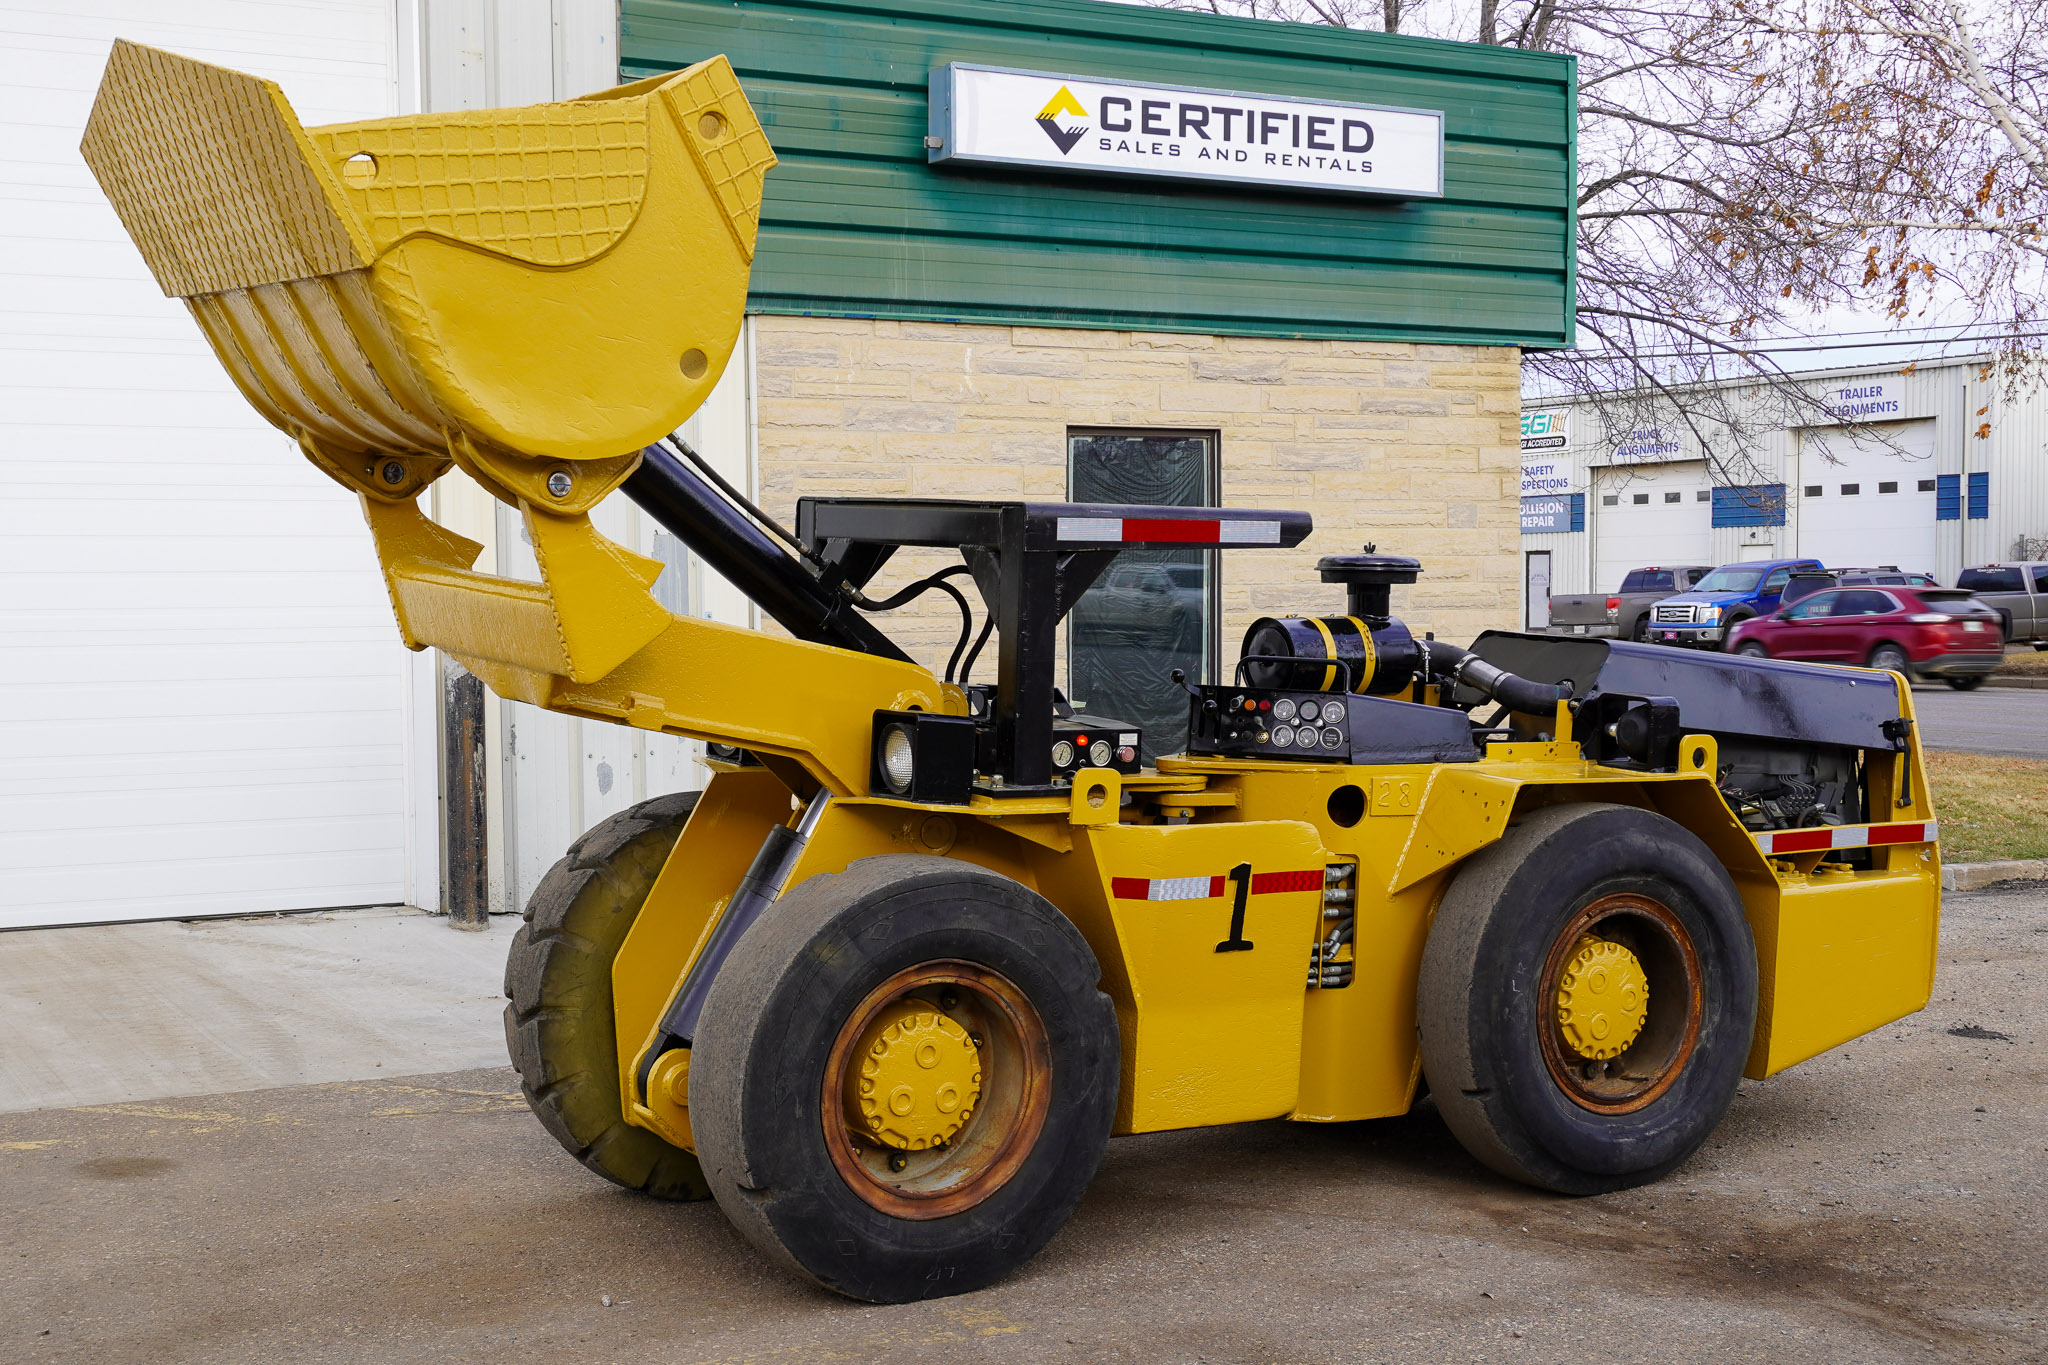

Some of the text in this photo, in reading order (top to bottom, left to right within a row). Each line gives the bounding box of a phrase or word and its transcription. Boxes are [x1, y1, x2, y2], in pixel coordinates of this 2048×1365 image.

[1100, 96, 1374, 153] CERTIFIED
[1099, 138, 1373, 173] SALES AND RENTALS
[1840, 386, 1883, 400] TRAILER
[1632, 429, 1663, 440] TRUCK
[1527, 438, 1564, 448] ACCREDITED
[1617, 442, 1679, 456] ALIGNMENTS
[1525, 465, 1555, 476] SAFETY
[1521, 478, 1569, 490] SPECTIONS
[1520, 502, 1564, 515] OLLISION
[1522, 516, 1555, 527] REPAIR
[1378, 781, 1410, 808] 28
[1213, 861, 1254, 954] 1
